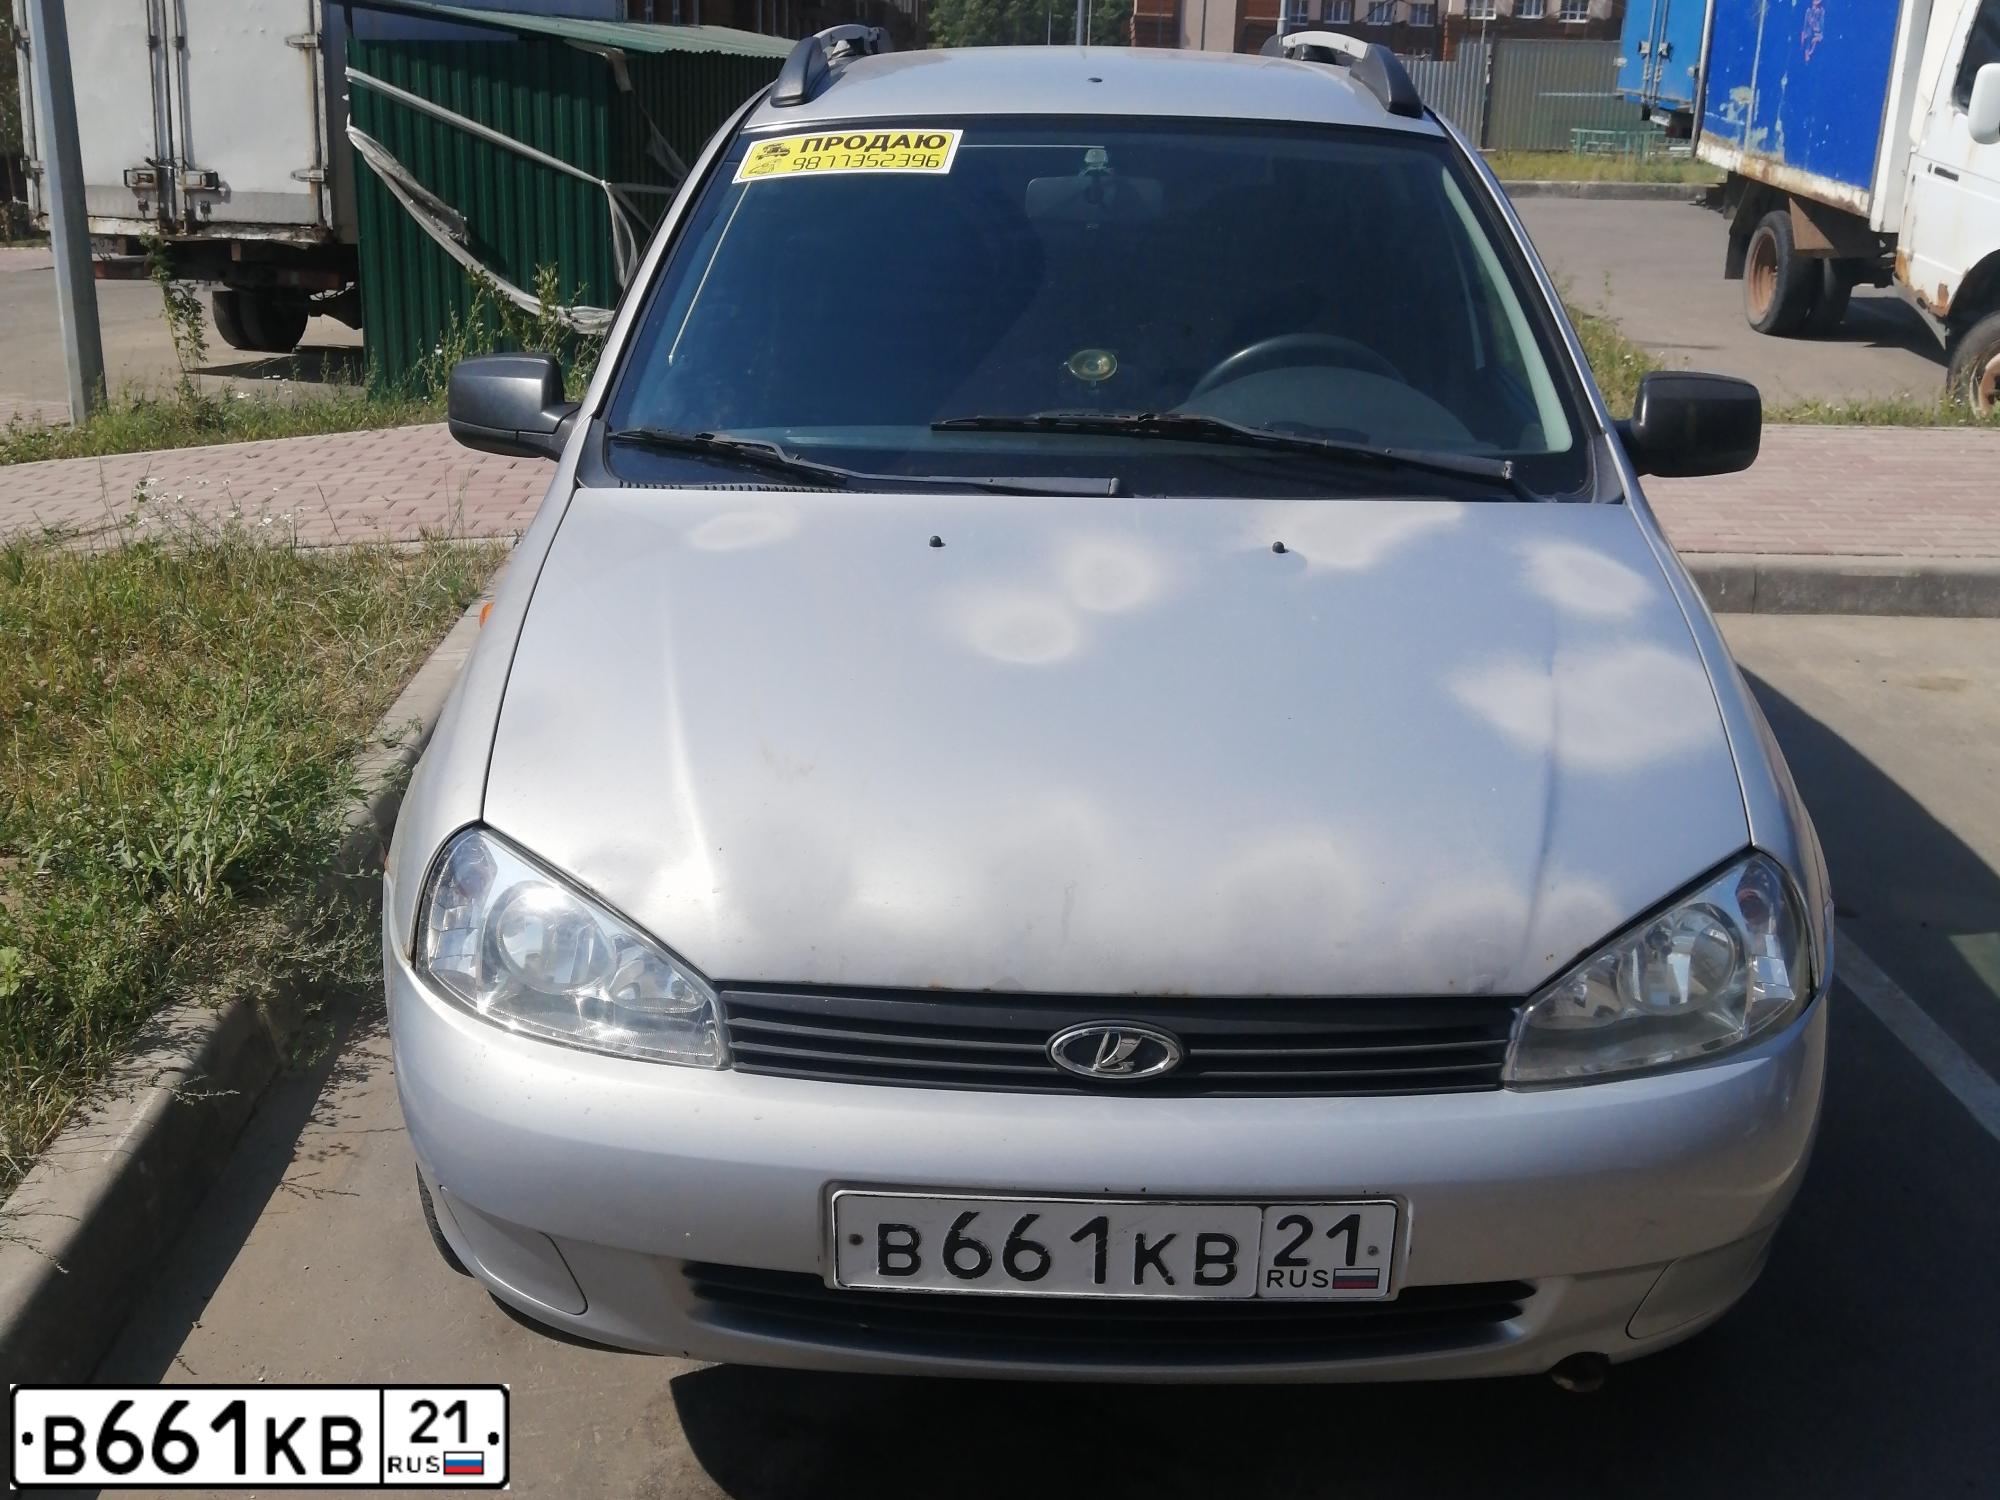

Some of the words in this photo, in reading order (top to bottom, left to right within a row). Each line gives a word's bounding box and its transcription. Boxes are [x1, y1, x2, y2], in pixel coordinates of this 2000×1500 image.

[800, 134, 947, 153] ПРОДАЮ
[1274, 1213, 1361, 1267] 21
[1266, 1269, 1329, 1289] RUS
